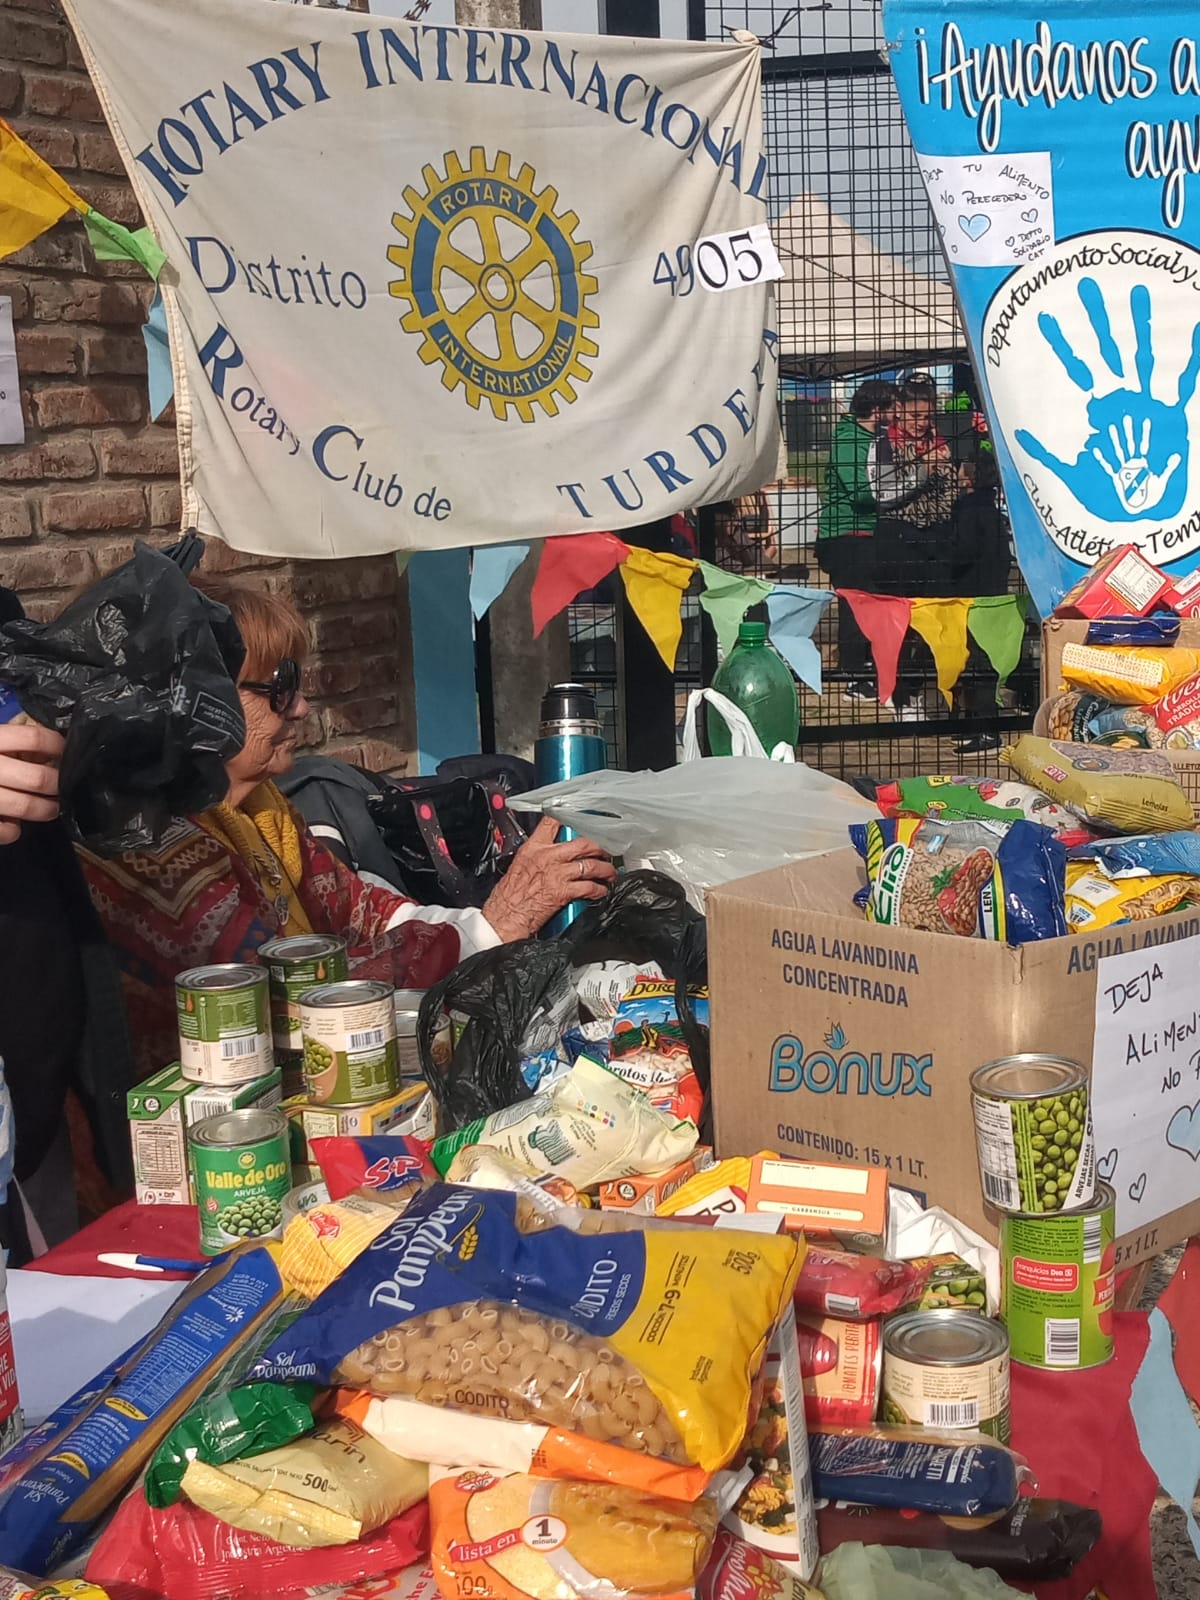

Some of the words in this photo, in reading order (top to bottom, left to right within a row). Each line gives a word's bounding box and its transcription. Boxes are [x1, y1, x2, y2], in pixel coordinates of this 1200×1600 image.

[962, 163, 982, 173] TU
[440, 182, 527, 215] ROTARY
[940, 193, 955, 205] NO
[185, 236, 367, 309] Distrito
[987, 245, 1107, 368] Departamento
[438, 333, 574, 394] INTERNATIONAL
[198, 322, 301, 456] Rotary
[312, 425, 403, 507] Club
[413, 486, 451, 521] de
[1023, 473, 1056, 529] Club
[771, 928, 817, 956] AGUA
[821, 936, 920, 975] LAVANDINA
[783, 963, 909, 1008] CONCENTRADA
[1104, 962, 1164, 1014] DEJA
[1162, 1066, 1181, 1094] NO
[776, 1123, 860, 1161] CONTENIDO:
[863, 1147, 880, 1166] 15
[896, 1156, 904, 1172] 1
[908, 1159, 928, 1179] LT.
[205, 1170, 242, 1189] Valle
[244, 1168, 264, 1187] de
[265, 1162, 287, 1180] Oro
[233, 1186, 266, 1199] ARVEJA
[658, 1289, 681, 1315] 7-9
[275, 1351, 294, 1366] Sol
[454, 1389, 510, 1411] CODITO
[536, 1518, 551, 1537] 1
[459, 1543, 493, 1562] lista
[497, 1531, 516, 1549] en
